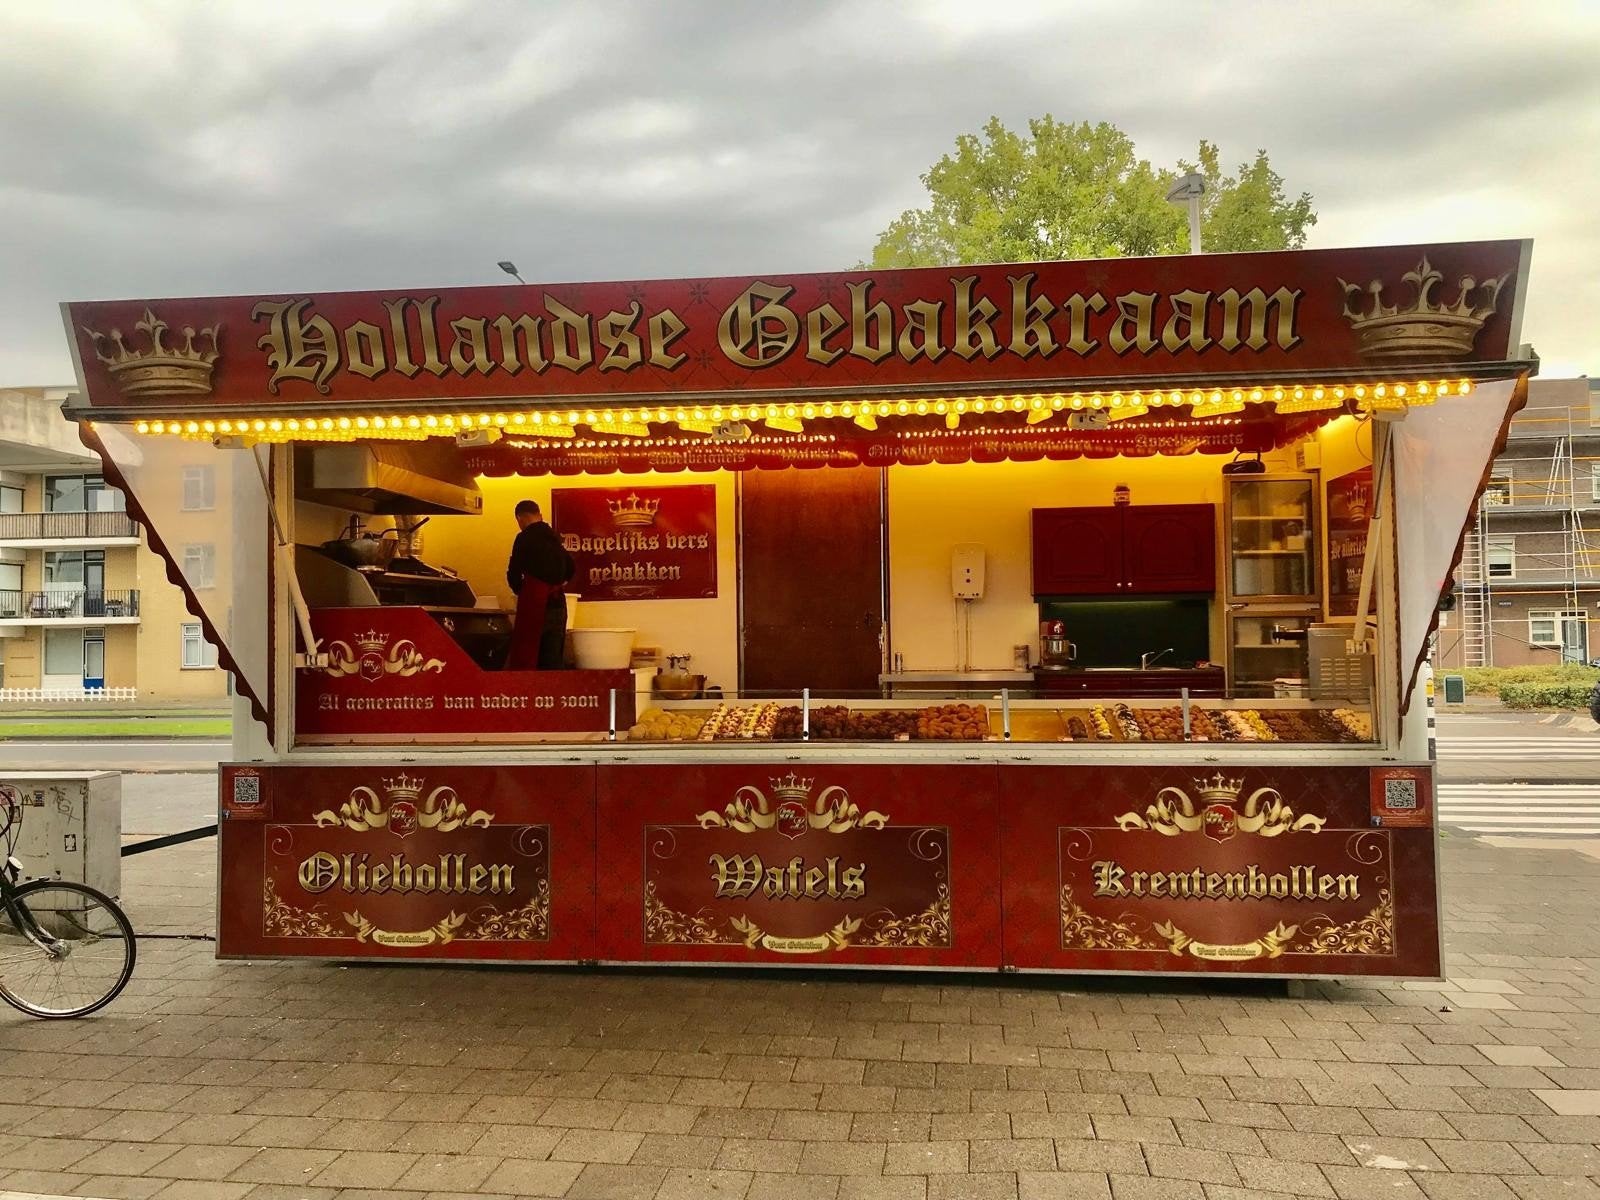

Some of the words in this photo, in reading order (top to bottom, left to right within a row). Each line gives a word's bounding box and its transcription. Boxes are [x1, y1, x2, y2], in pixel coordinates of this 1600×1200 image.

[252, 285, 688, 395] Hollandse
[718, 273, 1302, 368] Gebakkraam
[560, 531, 660, 555] Dagelijks
[665, 531, 709, 550] vers
[589, 561, 681, 585] gebakken
[318, 692, 340, 711] Al
[345, 692, 435, 712] generaties
[443, 693, 475, 710] van
[480, 693, 529, 710] vader
[534, 694, 554, 711] op
[560, 694, 600, 710] zoon
[298, 851, 516, 895] Oliebollen
[708, 853, 866, 899] Wafels
[1091, 860, 1361, 901] Krentenbollen
